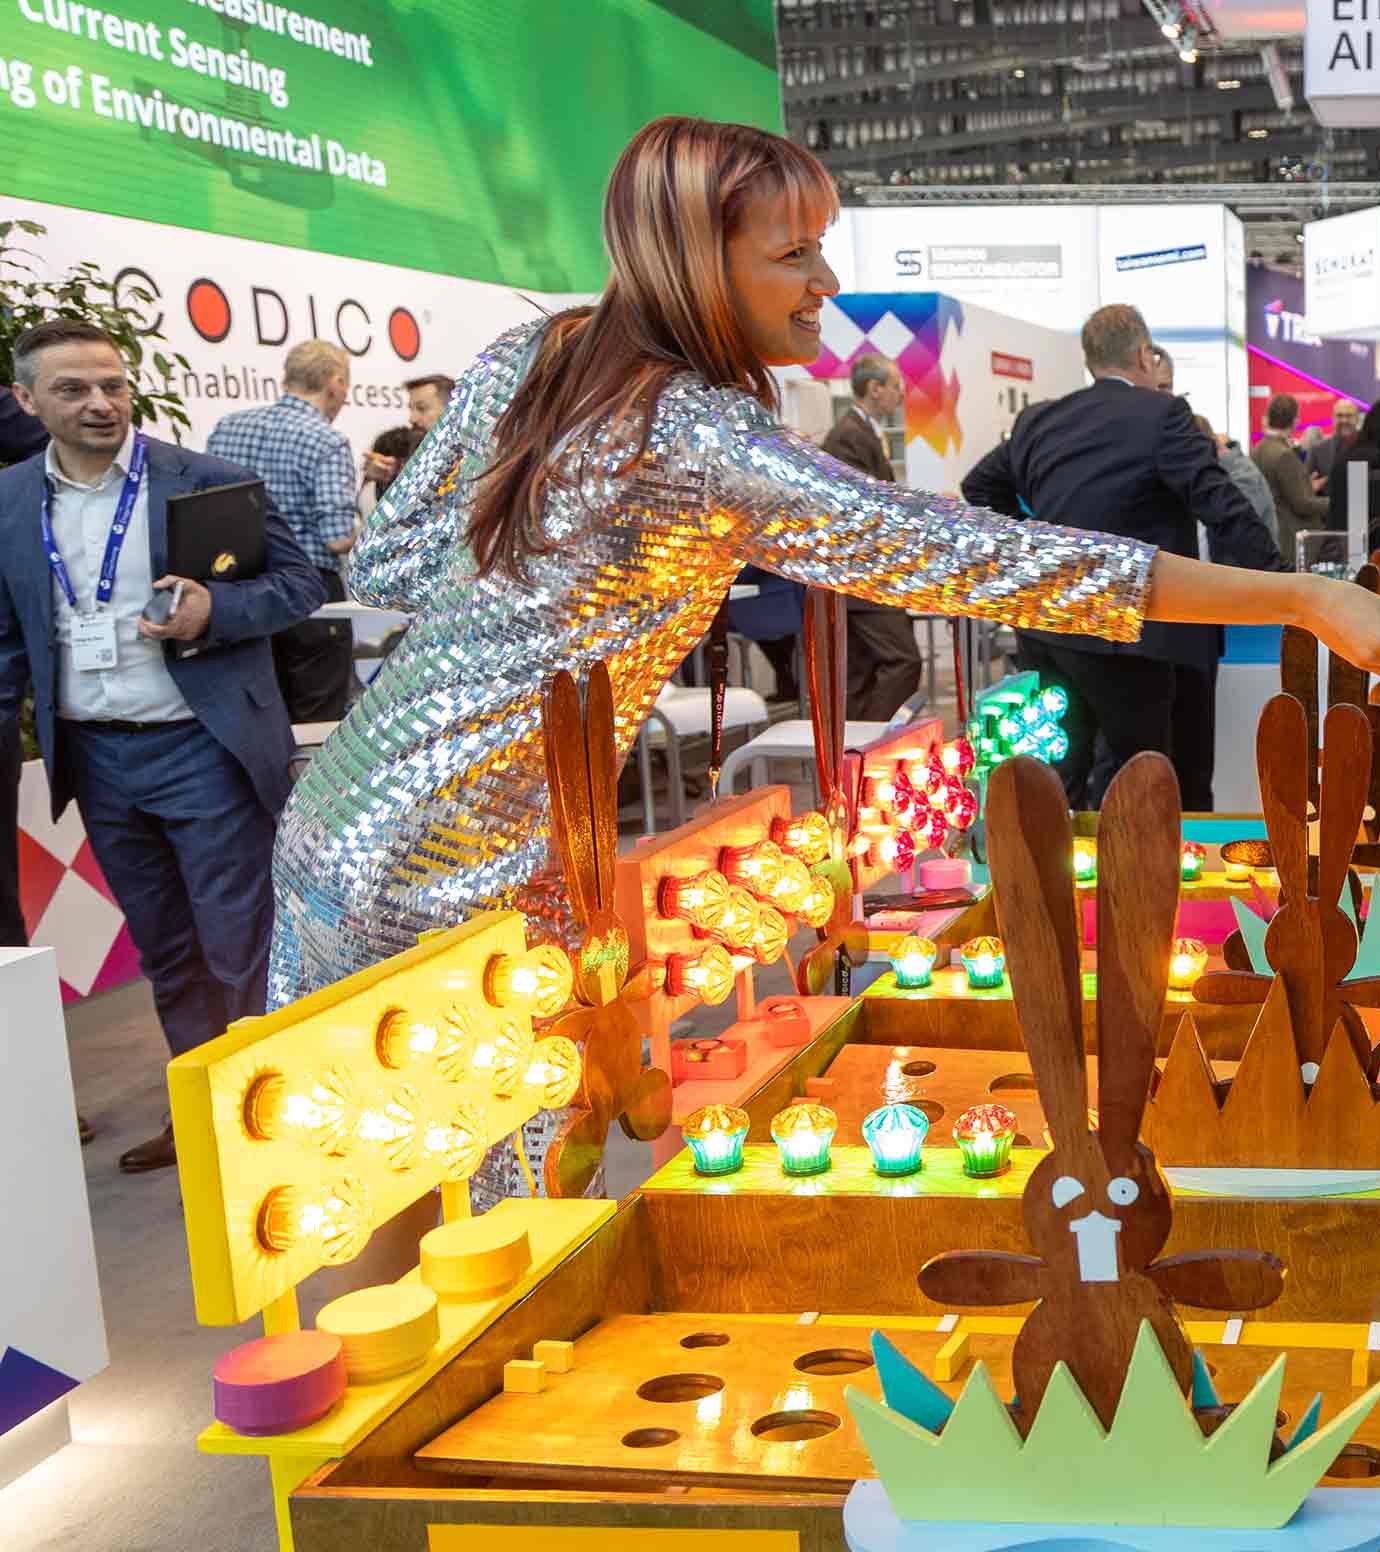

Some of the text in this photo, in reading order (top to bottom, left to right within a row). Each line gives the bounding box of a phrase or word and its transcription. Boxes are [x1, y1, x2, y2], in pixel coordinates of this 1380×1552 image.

[17, 0, 289, 107] Current Sensing
[187, 0, 374, 66] easurement
[1328, 31, 1373, 70] AI
[43, 65, 83, 109] of
[90, 74, 322, 171] Environmental
[326, 140, 387, 186] Data
[113, 267, 421, 362] CODICO
[164, 363, 403, 409] Enablin cess
